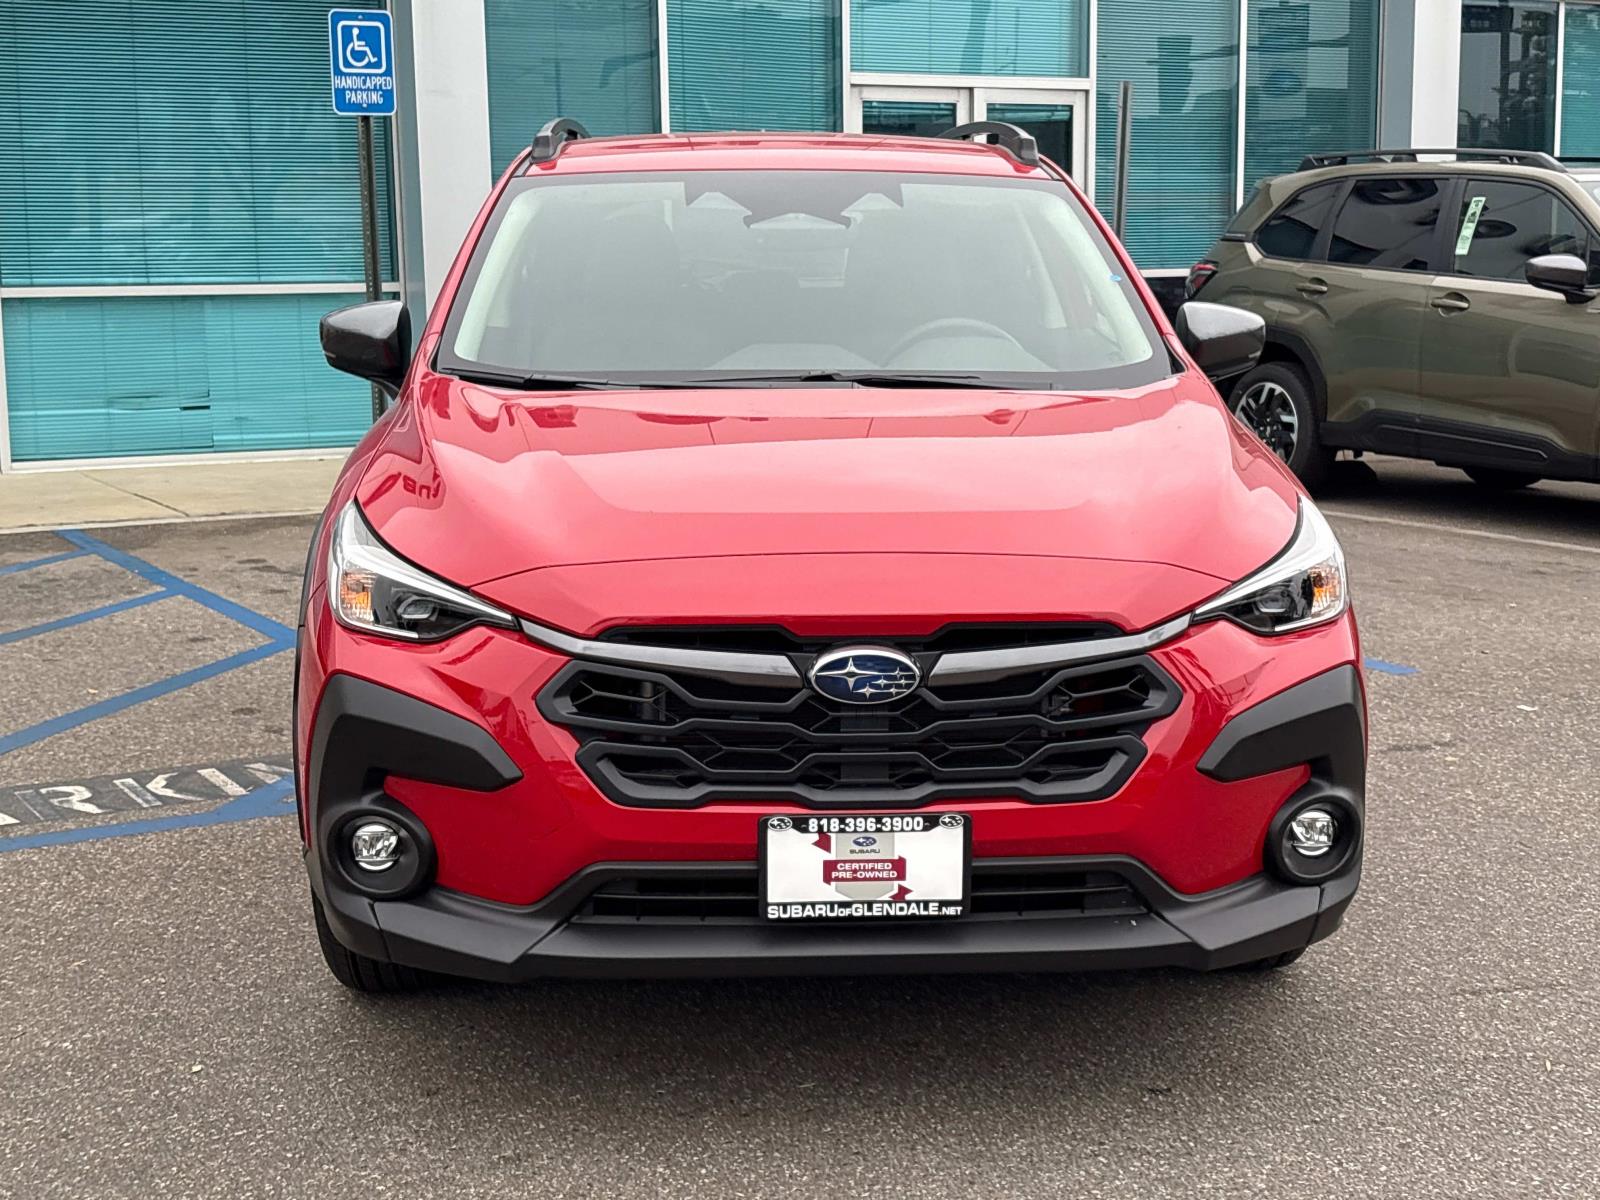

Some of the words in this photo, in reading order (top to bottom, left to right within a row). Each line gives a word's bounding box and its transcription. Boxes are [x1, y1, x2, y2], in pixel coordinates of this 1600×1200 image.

[334, 75, 392, 90] HANDICAPPED
[345, 90, 384, 104] PARKING
[808, 816, 924, 832] 818-396-3900
[836, 862, 893, 871] CERTIFIED
[831, 870, 898, 879] PRE-OWNED
